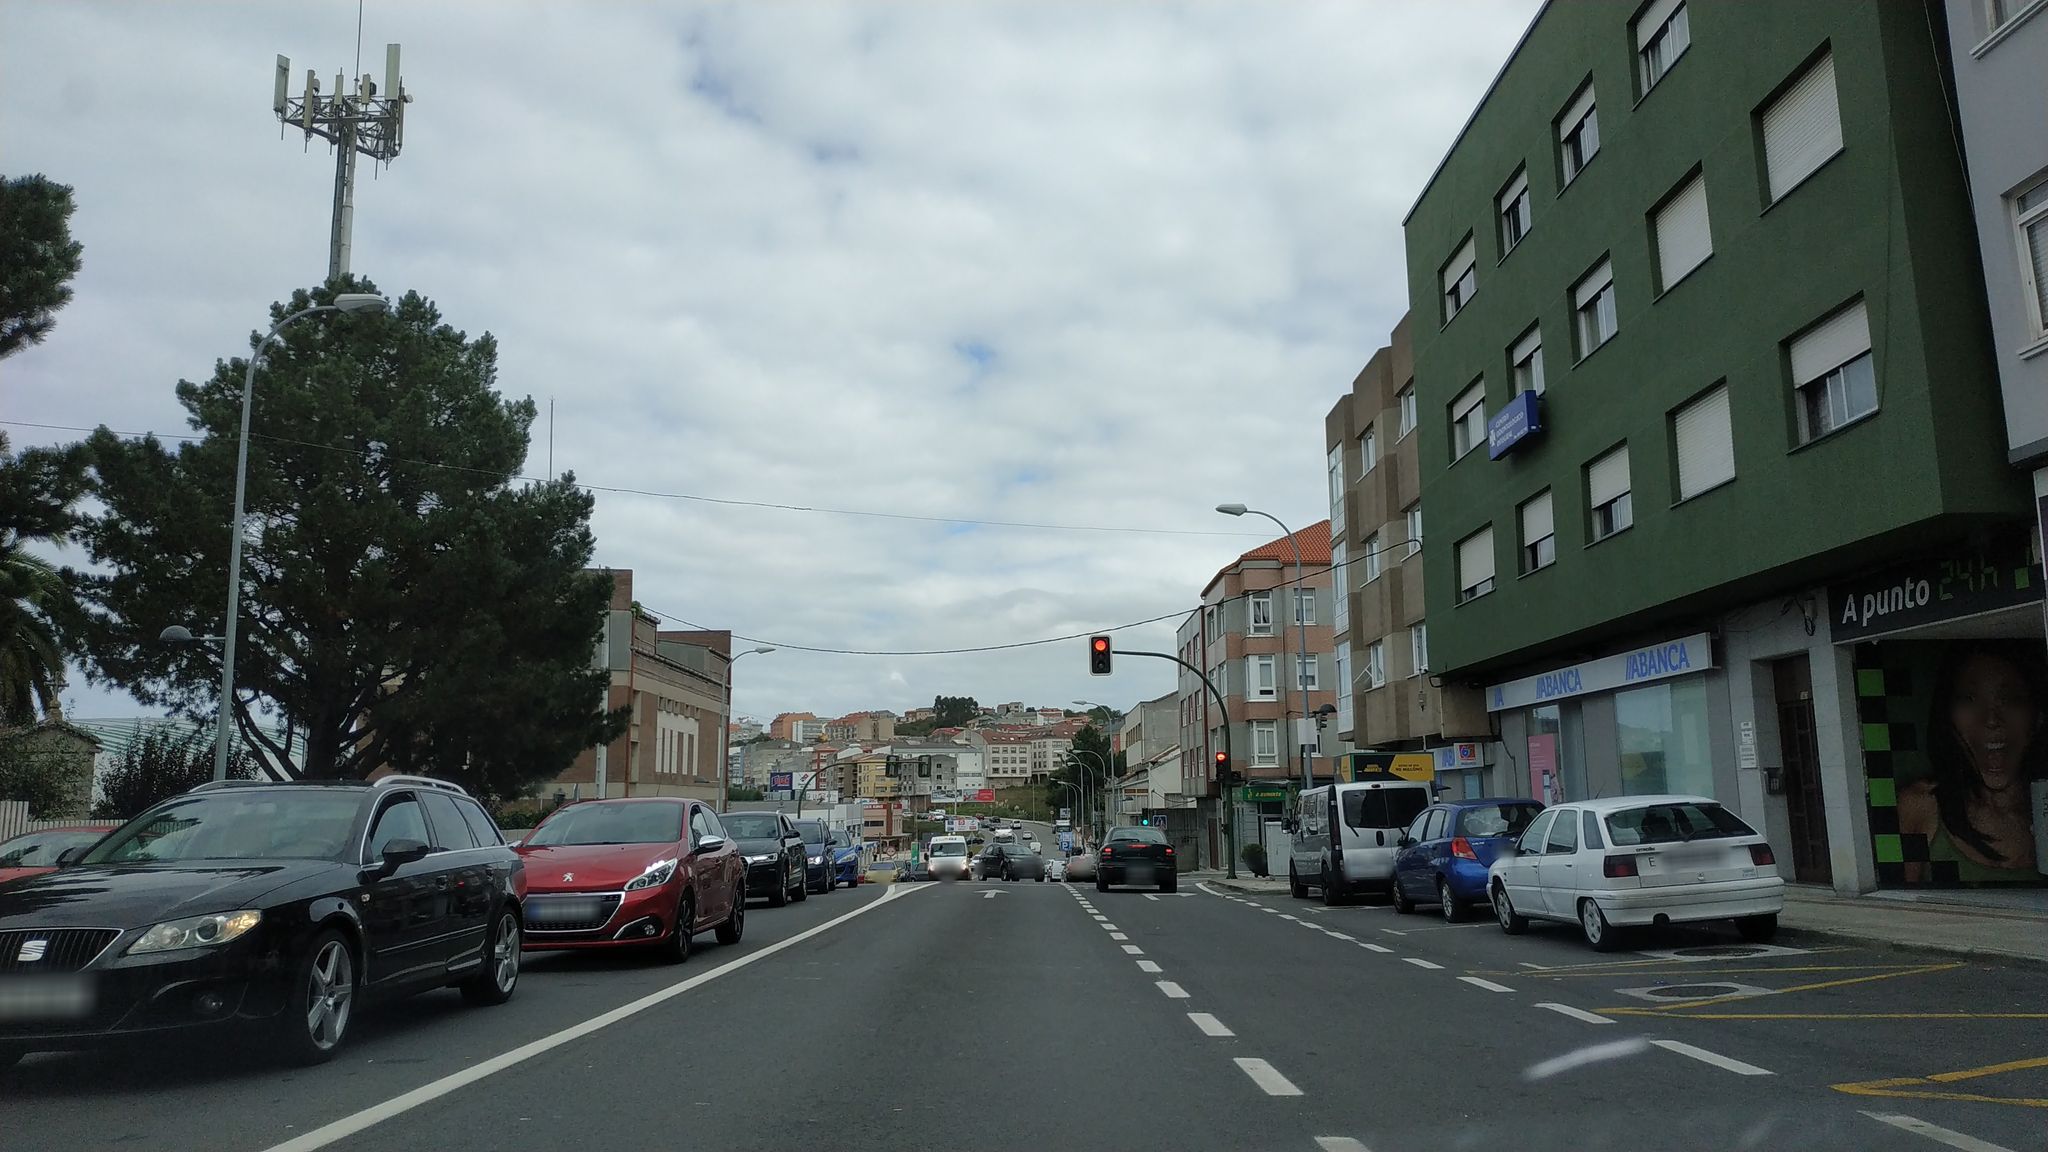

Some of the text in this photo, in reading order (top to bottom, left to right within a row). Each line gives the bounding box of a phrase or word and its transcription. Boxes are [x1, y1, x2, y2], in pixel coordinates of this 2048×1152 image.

[1842, 593, 1858, 624] A
[1862, 577, 1930, 627] punto
[1649, 857, 1656, 867] E
